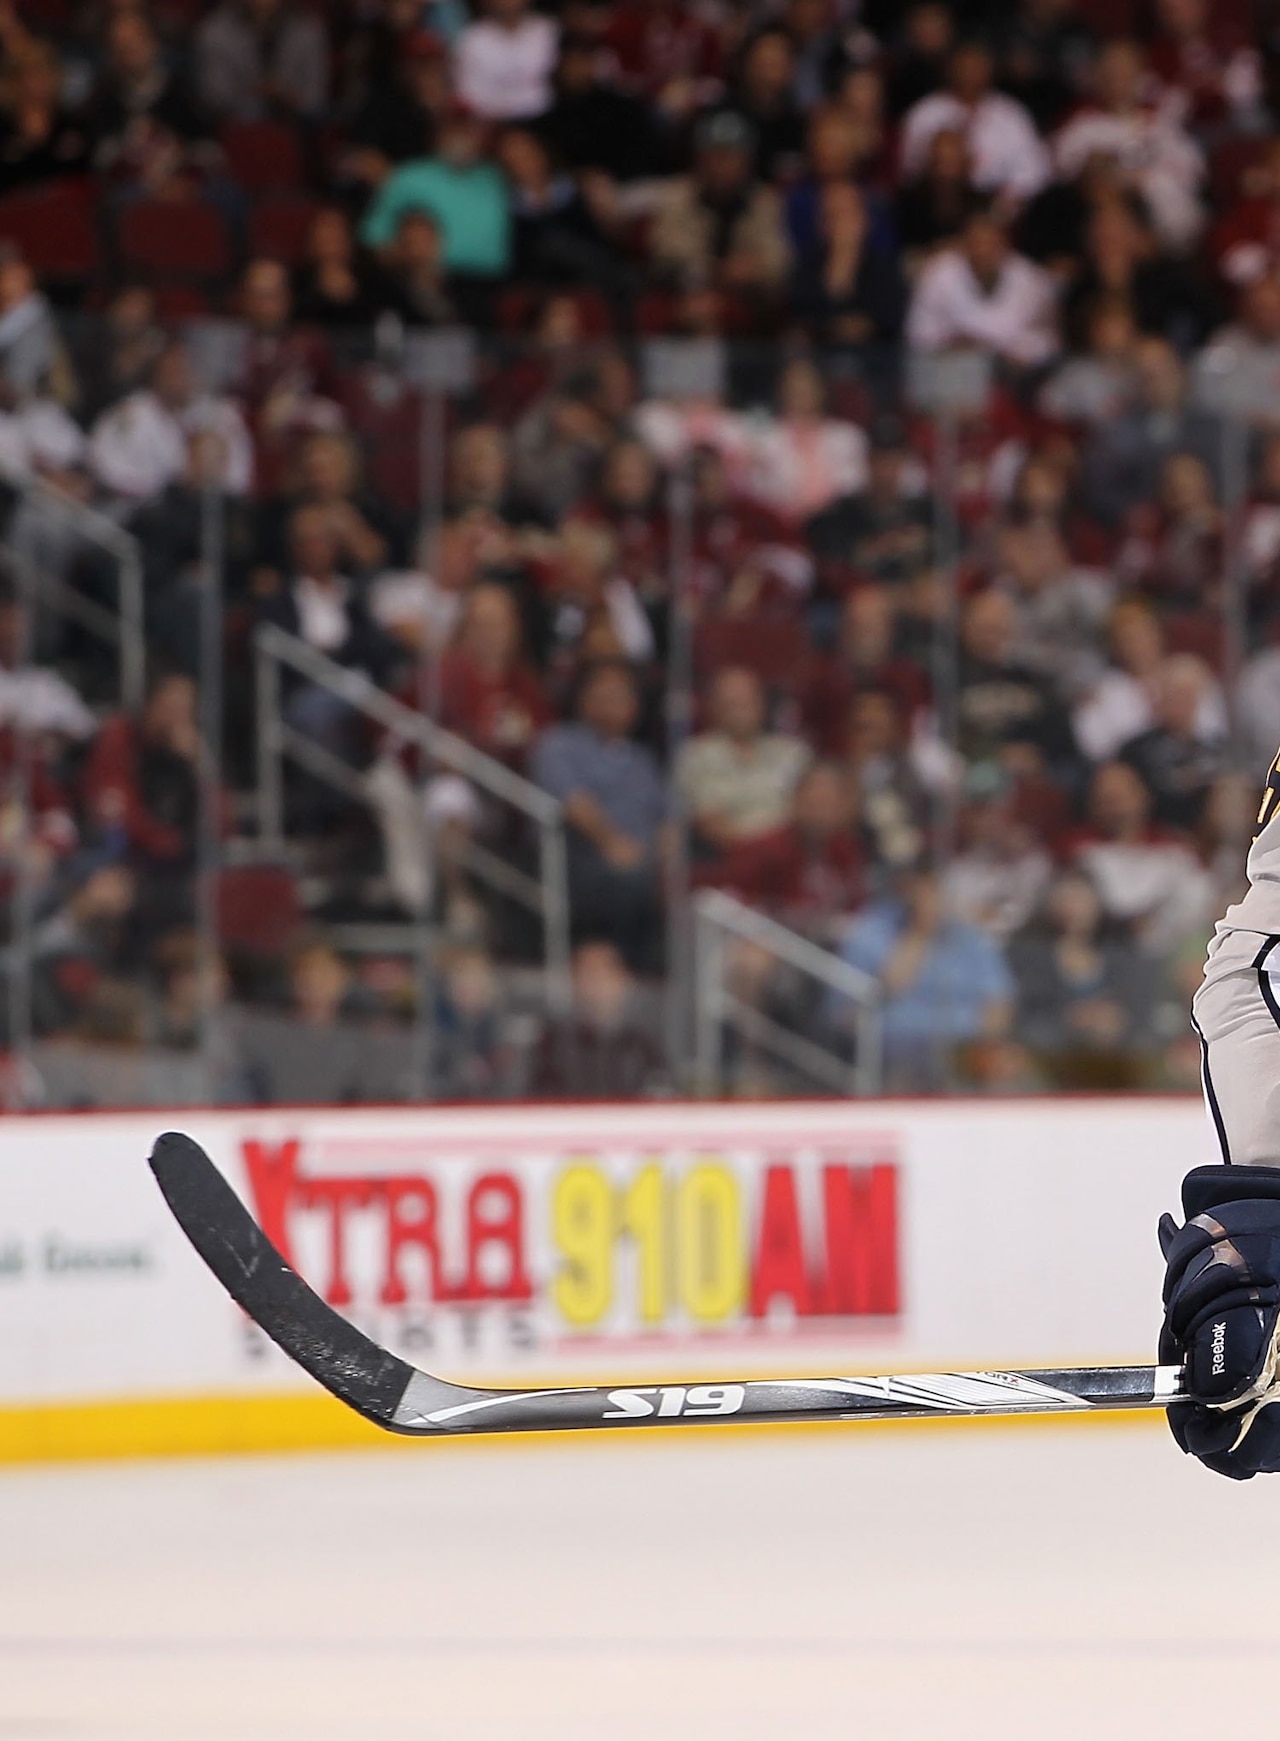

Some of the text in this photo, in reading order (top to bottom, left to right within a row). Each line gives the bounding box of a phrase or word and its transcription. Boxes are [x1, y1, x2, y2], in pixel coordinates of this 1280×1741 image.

[553, 1163, 742, 1324] 910
[745, 1163, 898, 1318] AM
[1212, 1321, 1227, 1376] Reebok
[602, 1385, 745, 1418] S19
